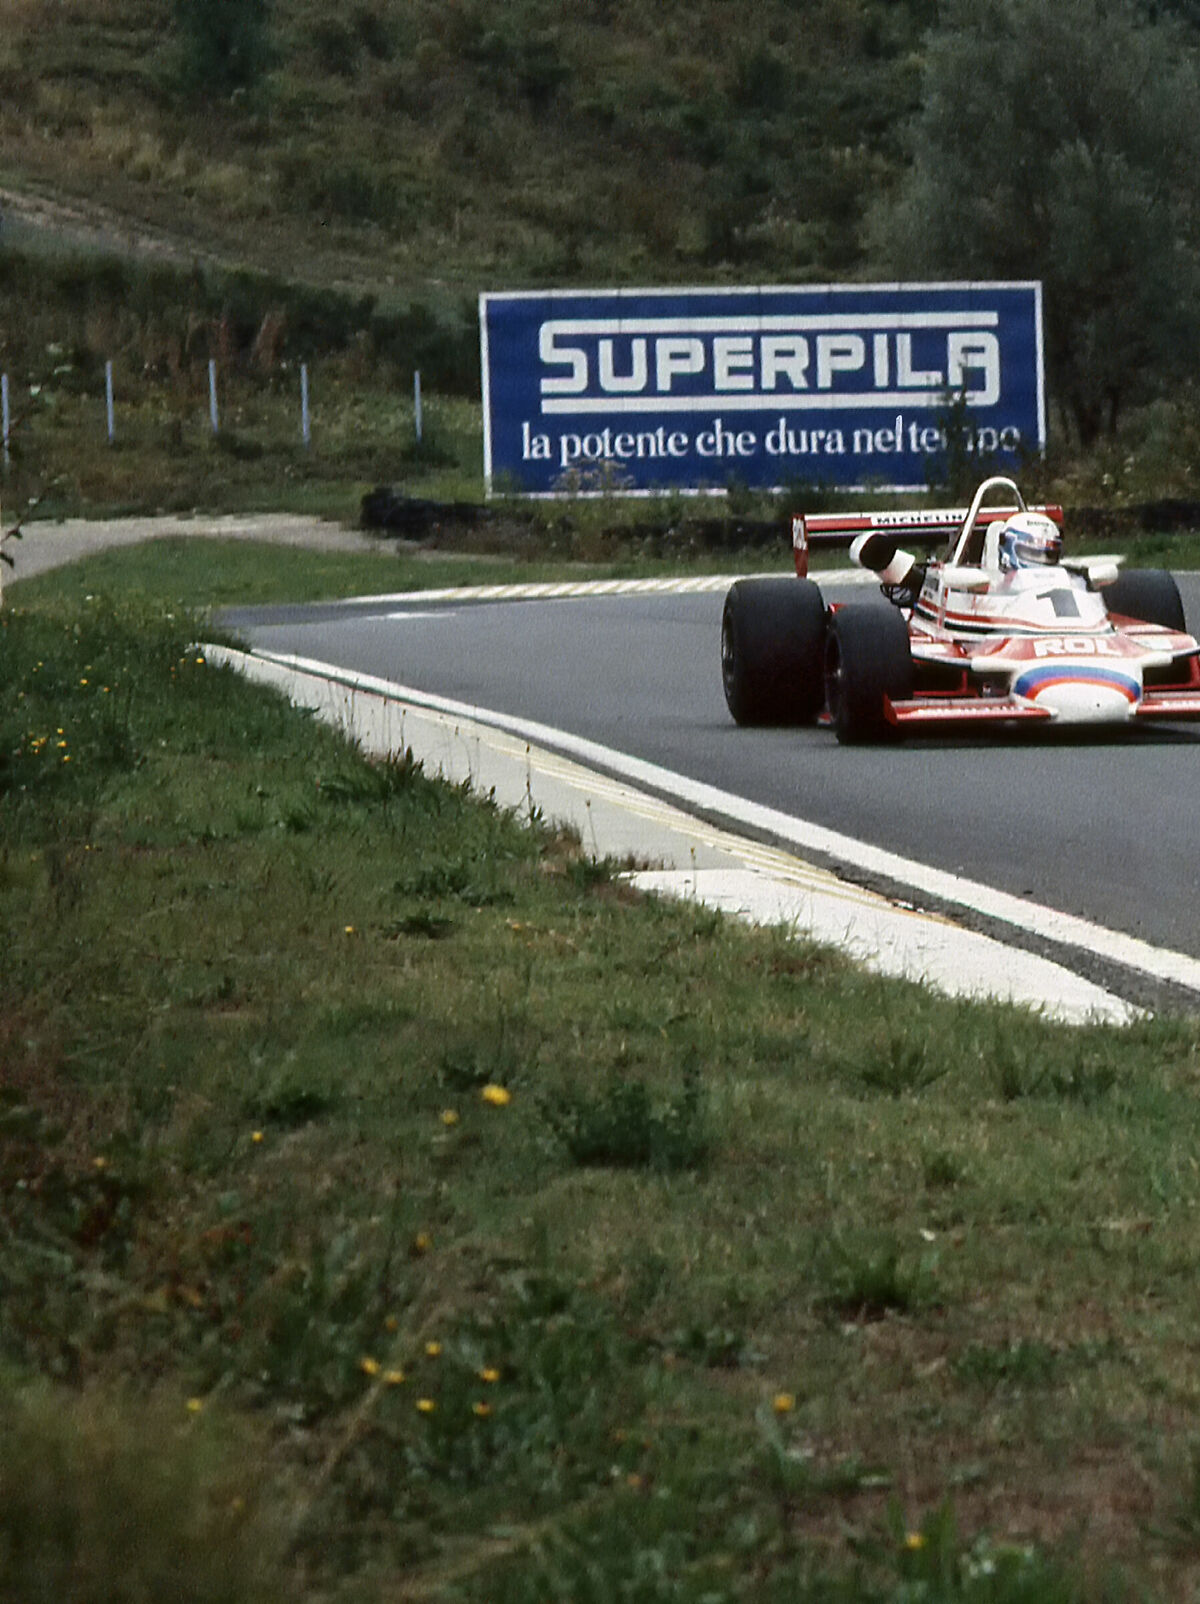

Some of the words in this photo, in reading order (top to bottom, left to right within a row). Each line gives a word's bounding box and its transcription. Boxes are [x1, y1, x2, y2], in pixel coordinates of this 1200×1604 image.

[539, 312, 1000, 414] SUPERPILA
[522, 421, 551, 460] la
[560, 426, 688, 467] potente
[696, 417, 756, 457] che
[765, 415, 844, 455] dura
[854, 415, 902, 454] nel
[876, 513, 963, 525] MICHELIN
[1035, 588, 1081, 618] 1
[1033, 637, 1123, 658] ROL
